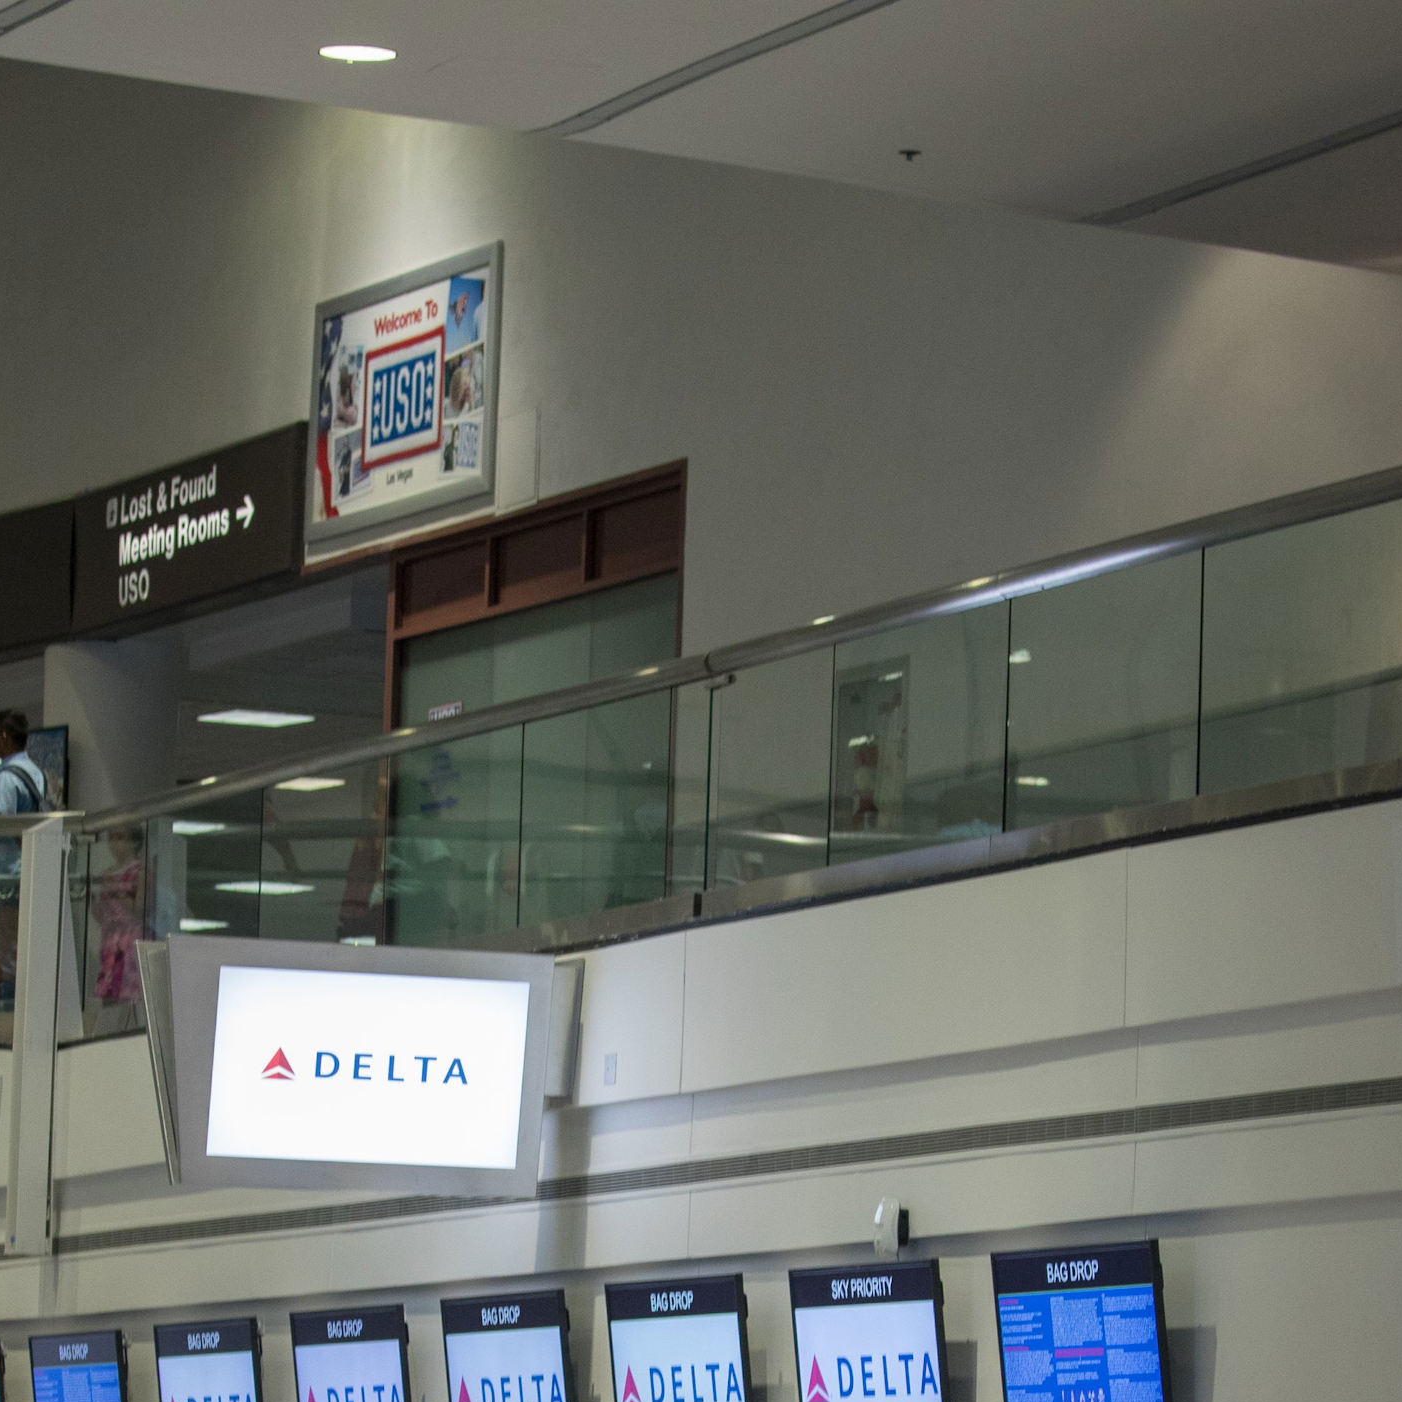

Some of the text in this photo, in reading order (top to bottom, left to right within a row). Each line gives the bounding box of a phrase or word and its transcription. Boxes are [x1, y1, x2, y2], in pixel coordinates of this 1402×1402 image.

[374, 299, 438, 337] Welcome To
[380, 360, 425, 438] USO
[120, 463, 218, 526] Lost & Found
[119, 507, 230, 567] Meeting Rooms
[118, 567, 150, 608] USO
[314, 1051, 469, 1086] DELTA
[1047, 1259, 1099, 1284] BAG DROP
[650, 1291, 693, 1312] BAG DROP
[831, 1276, 893, 1300] SKY PRIORITY
[327, 1319, 363, 1338] BAG DROP
[481, 1305, 520, 1326] BAG DROP
[59, 1343, 89, 1361] BAG DROP
[187, 1331, 220, 1350] BAG DROP
[837, 1352, 939, 1398] DELTA
